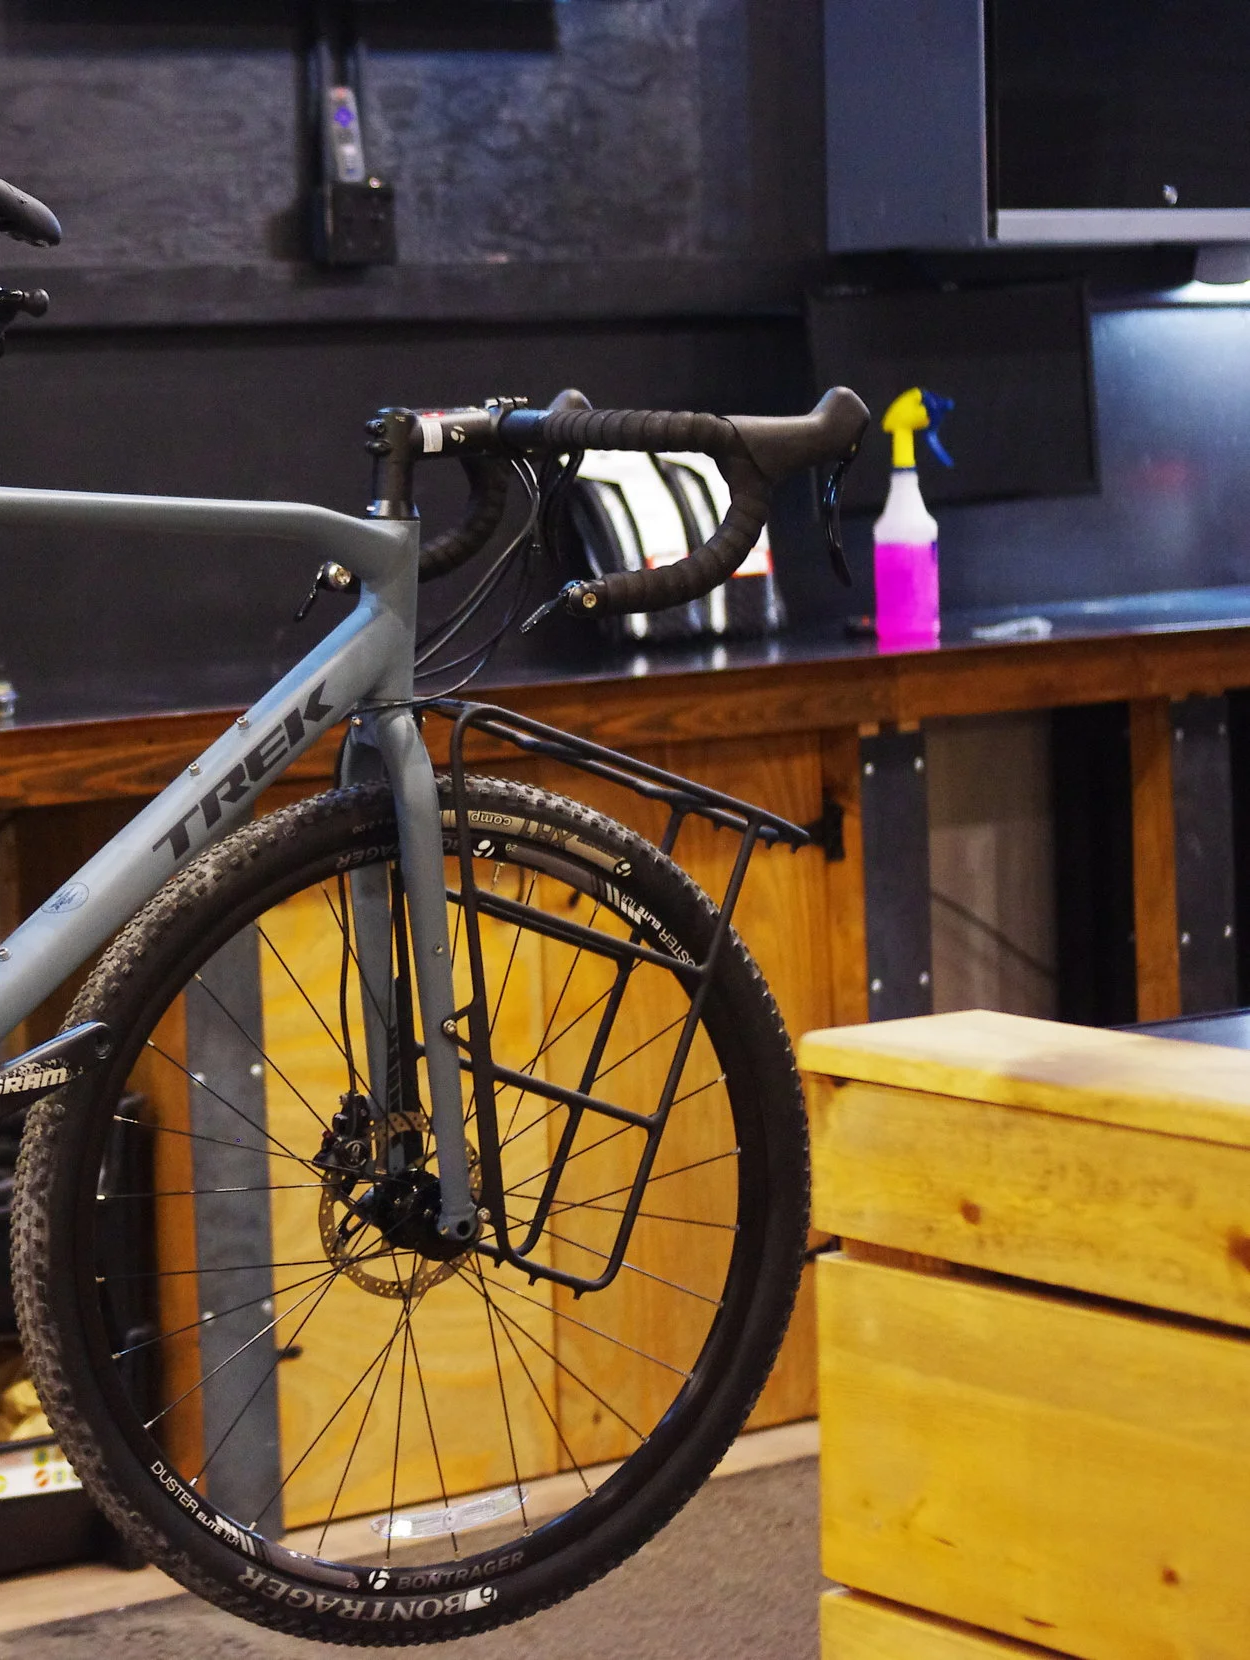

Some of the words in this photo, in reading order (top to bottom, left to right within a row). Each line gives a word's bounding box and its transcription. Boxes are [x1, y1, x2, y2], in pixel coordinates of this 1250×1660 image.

[152, 680, 334, 860] TREK
[470, 810, 513, 827] comp
[505, 843, 518, 853] 29
[636, 906, 662, 931] ELITE
[658, 928, 696, 968] USTER
[150, 1460, 199, 1514] DUSTER
[196, 1511, 221, 1535] ELITE
[223, 1531, 240, 1547] TLR
[396, 1551, 524, 1590] BONTRAGER
[237, 1566, 469, 1621] BONTRAGER
